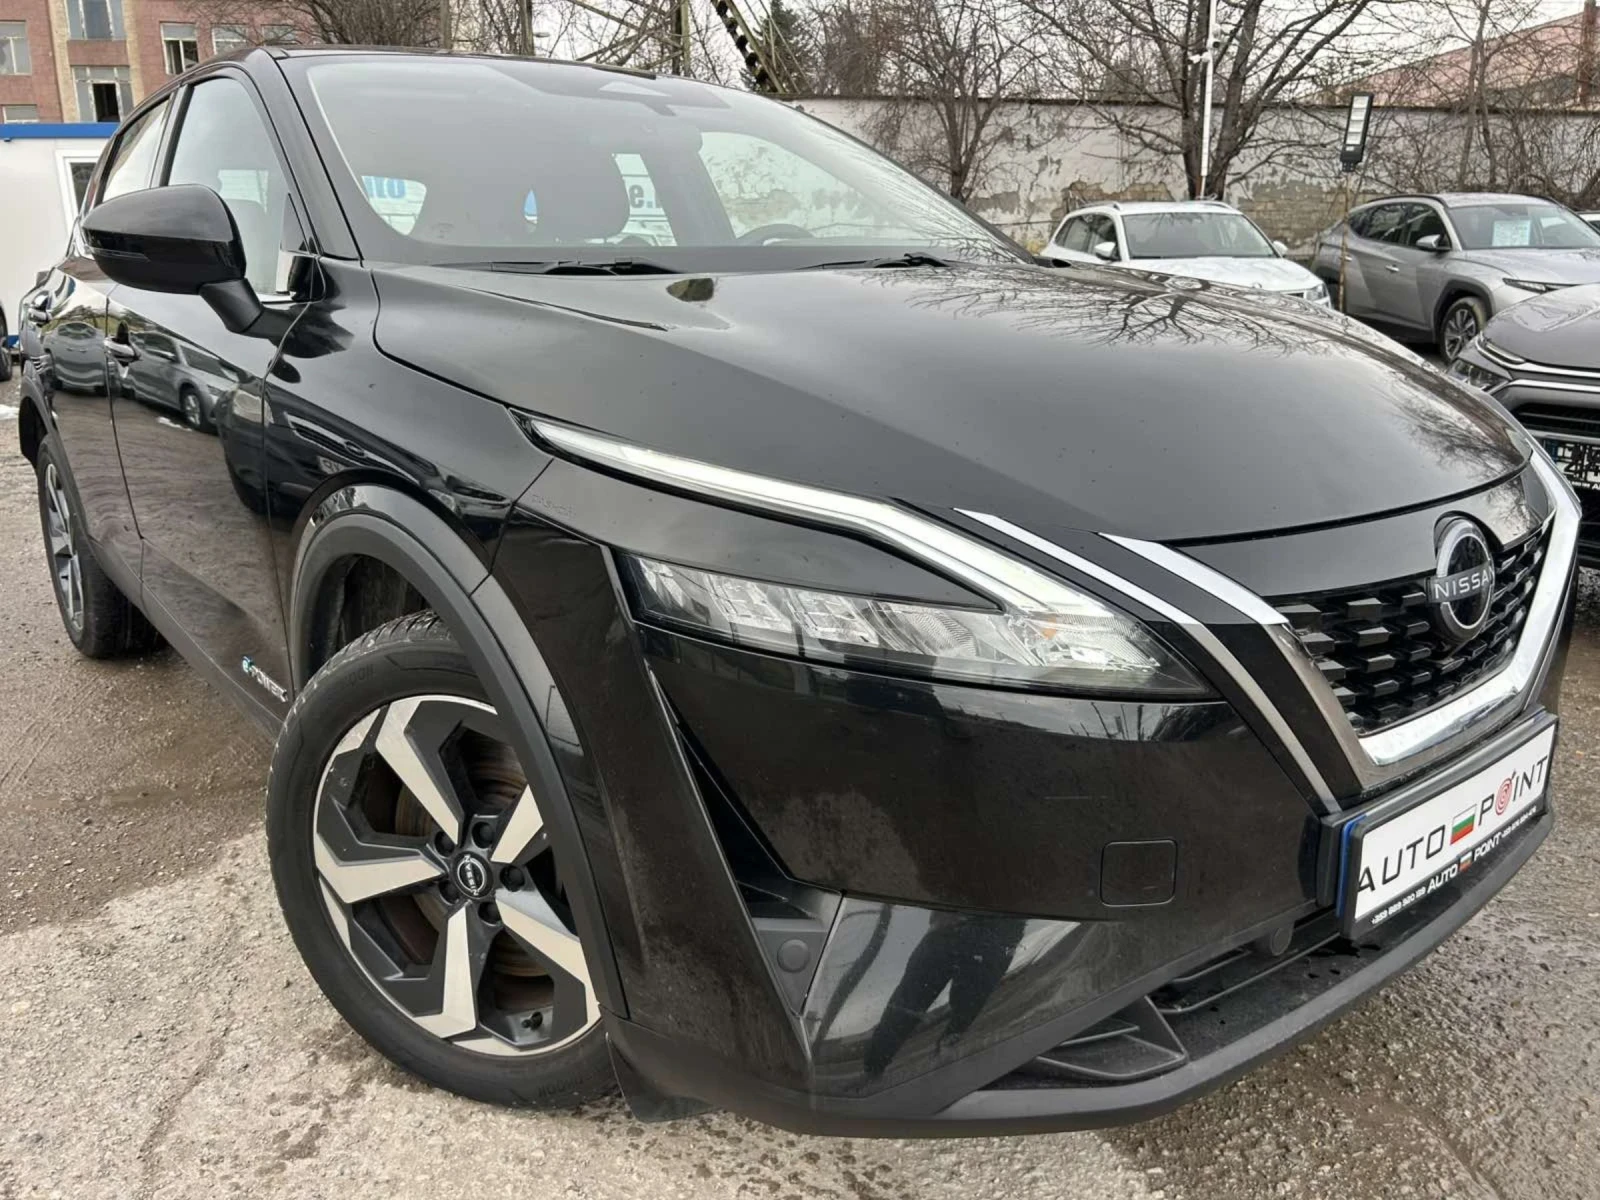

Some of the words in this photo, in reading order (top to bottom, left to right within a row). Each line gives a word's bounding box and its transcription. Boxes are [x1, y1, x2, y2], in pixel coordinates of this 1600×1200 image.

[1434, 569, 1491, 599] NISSA
[1357, 824, 1446, 894] AUTO
[1427, 863, 1458, 894] AUTO
[1473, 831, 1502, 862] POINT
